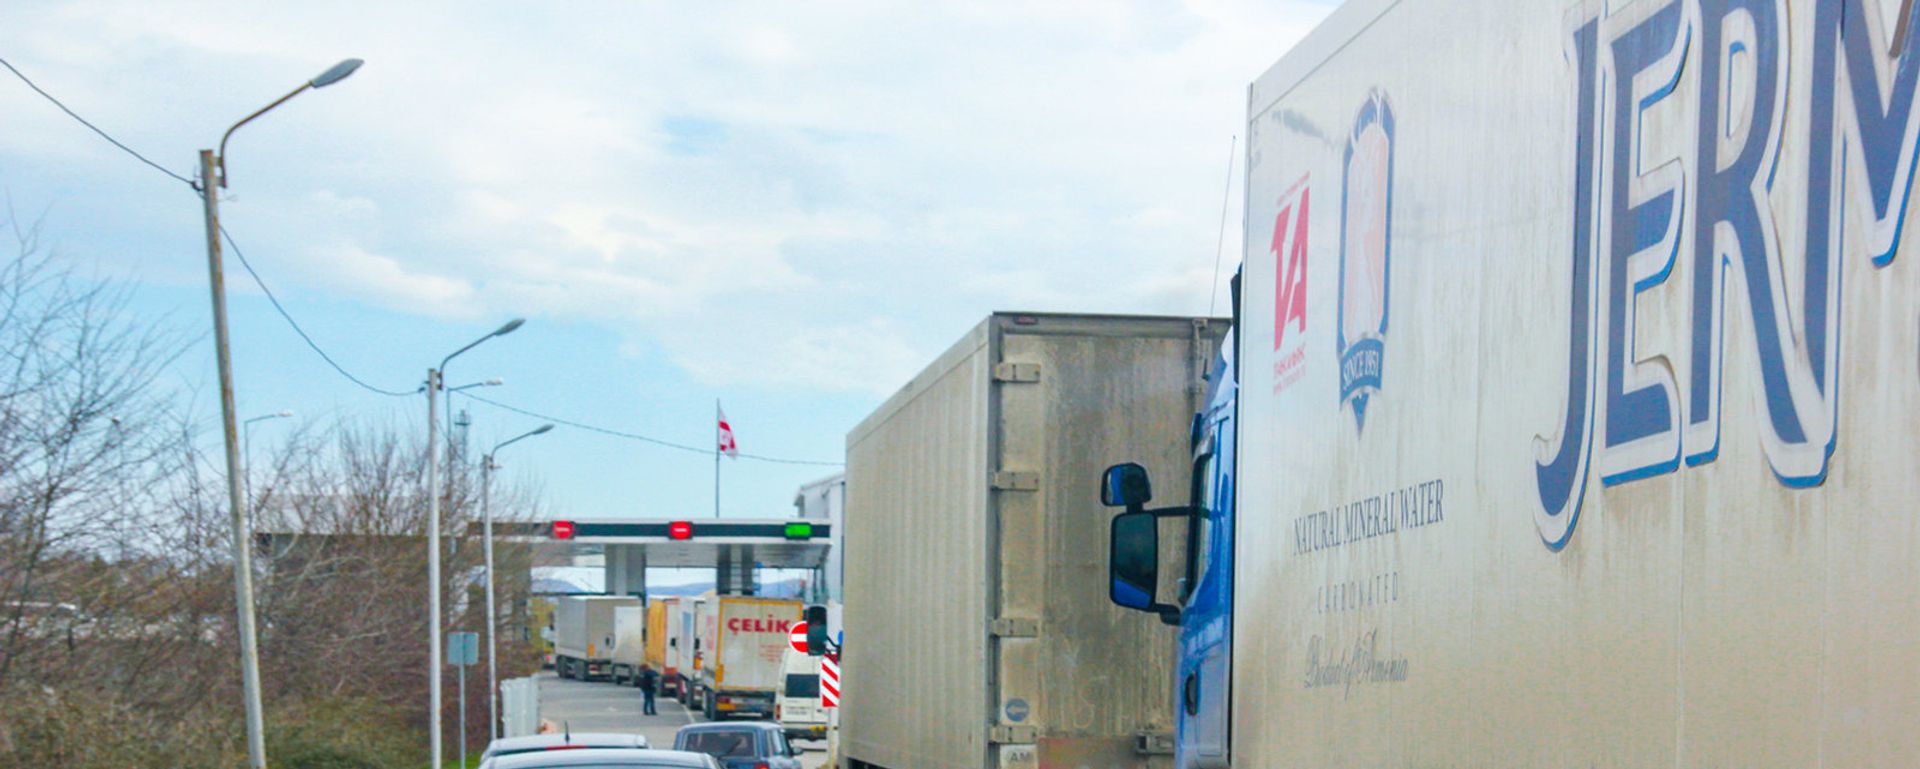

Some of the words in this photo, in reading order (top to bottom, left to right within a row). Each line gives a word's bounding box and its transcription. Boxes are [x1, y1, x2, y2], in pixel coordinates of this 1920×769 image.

[1343, 351, 1363, 388] SINCE
[1293, 507, 1342, 556] NATURAL
[1343, 491, 1397, 544] MINERAL
[1399, 478, 1444, 529] WATER
[1317, 571, 1400, 614] CARBONATED
[727, 614, 791, 636] ÇELİK
